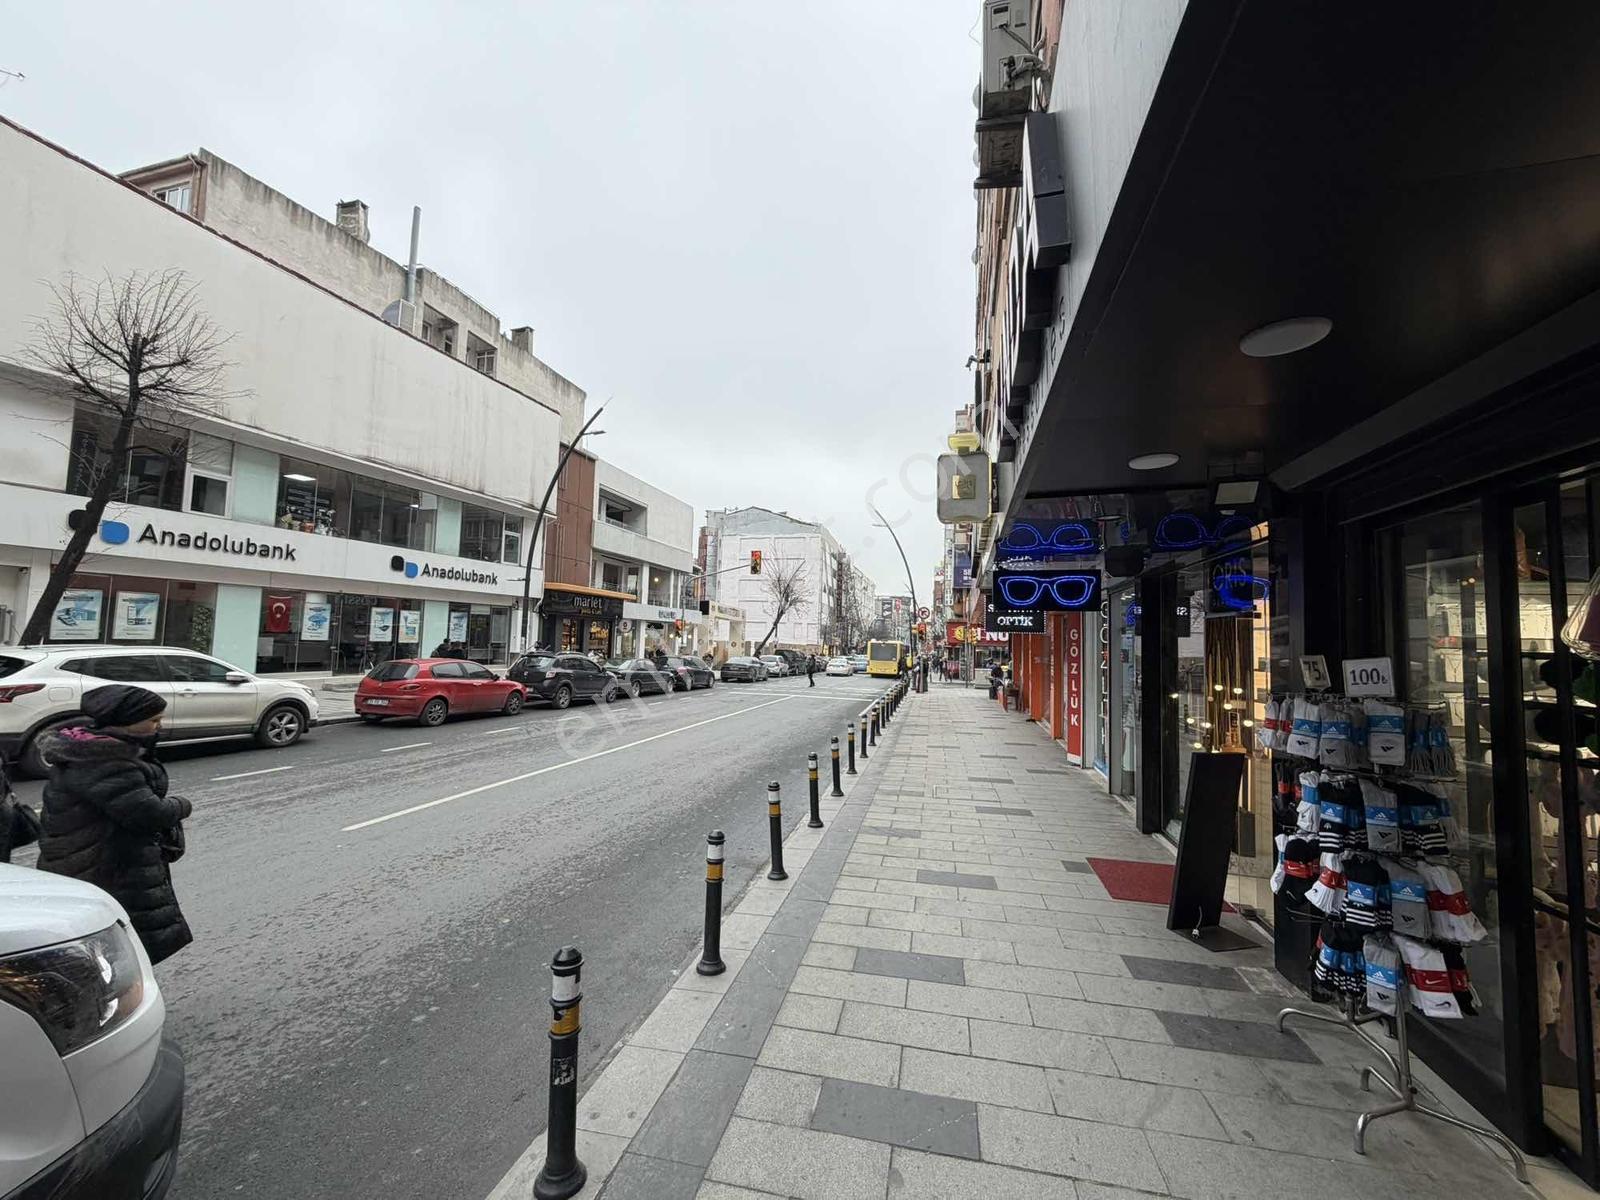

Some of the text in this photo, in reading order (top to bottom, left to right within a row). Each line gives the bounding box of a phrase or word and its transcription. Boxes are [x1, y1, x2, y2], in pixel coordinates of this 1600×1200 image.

[136, 523, 297, 561] Anadolubank
[421, 562, 498, 587] Anadolubank
[997, 615, 1034, 627] OPTİK
[1069, 628, 1080, 727] GÖZLÜK
